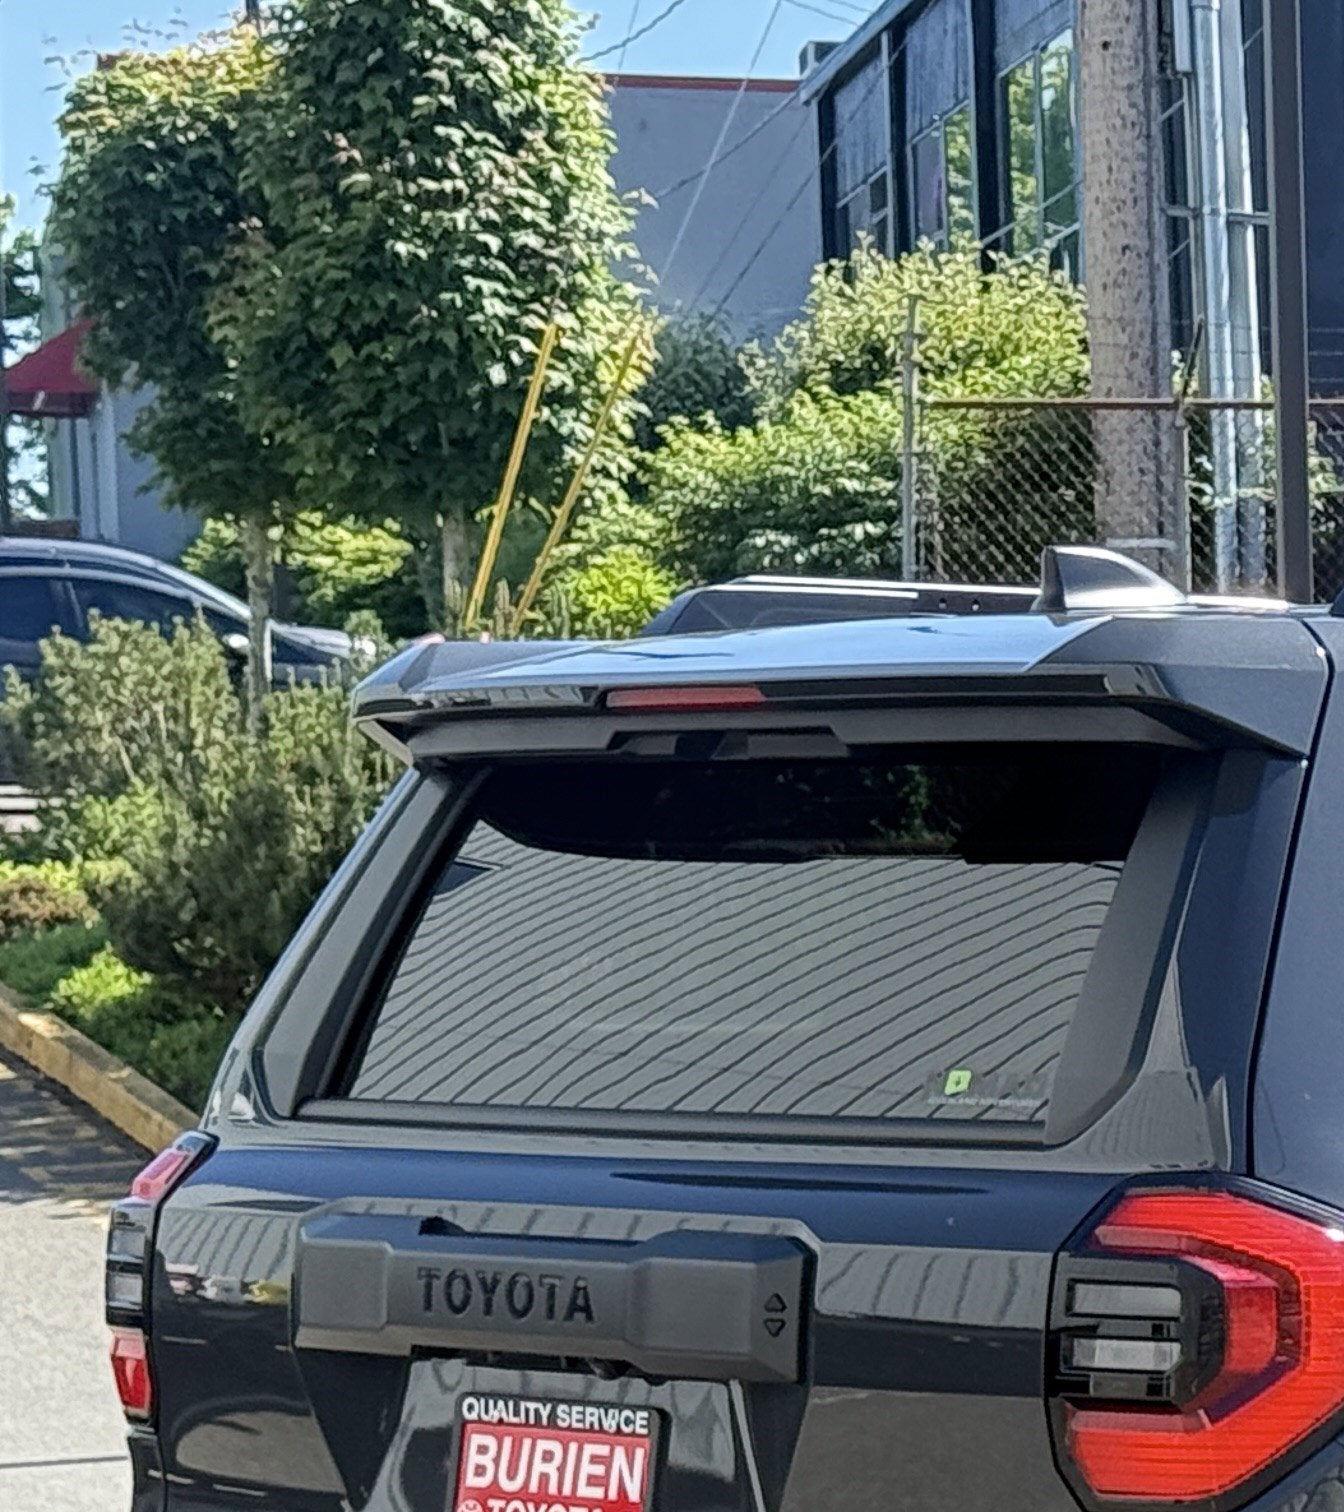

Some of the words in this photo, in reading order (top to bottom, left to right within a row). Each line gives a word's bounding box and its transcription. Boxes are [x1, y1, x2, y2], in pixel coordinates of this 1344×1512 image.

[416, 1266, 596, 1324] TOYOTA
[461, 1396, 552, 1427] QUALITY
[556, 1403, 650, 1435] SERVICE
[464, 1432, 646, 1504] BURIEN
